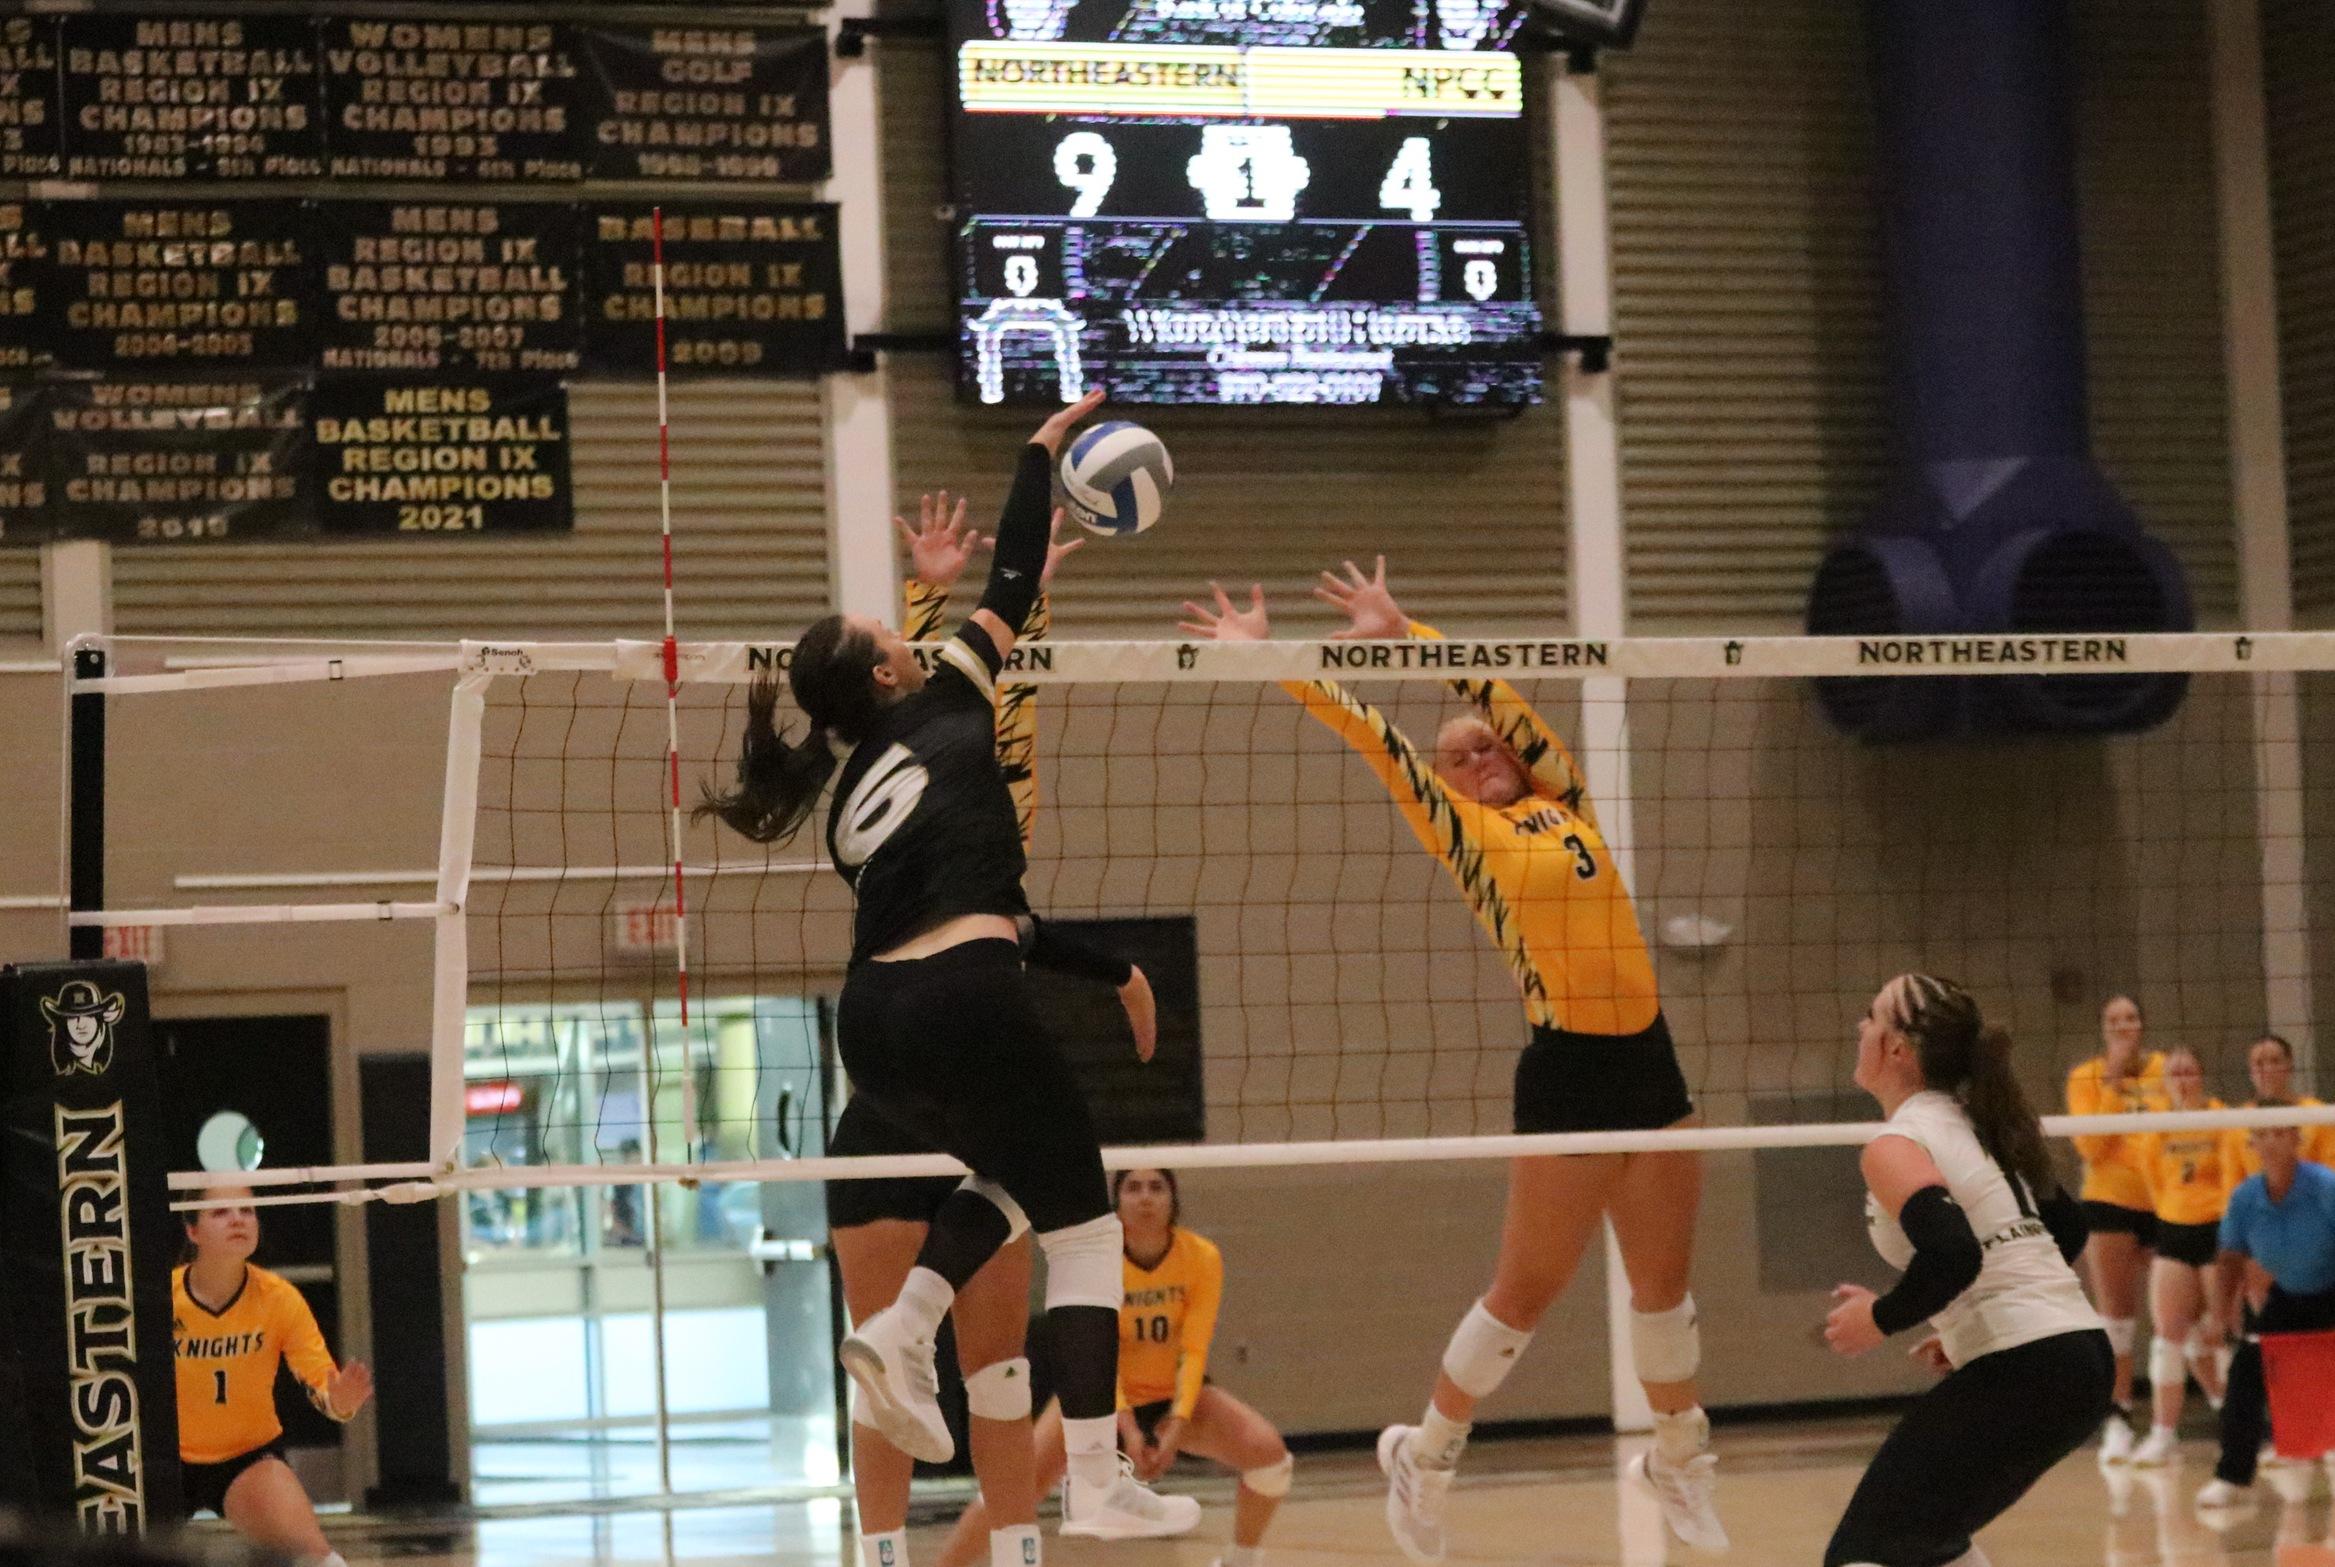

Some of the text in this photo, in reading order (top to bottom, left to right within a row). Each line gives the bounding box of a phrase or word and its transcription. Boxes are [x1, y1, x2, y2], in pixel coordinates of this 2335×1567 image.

[136, 20, 243, 47] MENS
[350, 23, 552, 50] WOMENS
[70, 49, 313, 75] BASKETBALL
[329, 50, 576, 78] VOLLEYBALL
[661, 58, 752, 83] GOLF
[973, 58, 1240, 88] NORTHEASTERN
[100, 77, 283, 102] REGION IX
[362, 79, 543, 104] REGION IX
[615, 90, 796, 117] REGION IX
[80, 104, 306, 131] CHAMPIONS
[343, 104, 566, 132] CHAMPIONS
[598, 121, 818, 147] CHAMPIONS
[1053, 132, 1117, 218] 9
[1236, 157, 1264, 209] 1
[1379, 137, 1440, 221] 4
[123, 210, 233, 237] MENS
[392, 207, 499, 234] MENS
[598, 215, 823, 242] BASEBALL
[58, 239, 302, 266] BASKETBALL
[354, 237, 537, 264] REGION IX
[88, 270, 274, 297] REGION IX
[327, 265, 568, 292] BASKETBALL
[623, 262, 802, 288] REGION IX
[1004, 256, 1038, 297] 0
[1464, 260, 1497, 301] 0
[67, 300, 297, 329] CHAMPIONS
[337, 294, 561, 322] CHAMPIONS
[603, 293, 826, 320] CHAMPIONS
[323, 350, 440, 369] NATIONALS
[91, 384, 261, 406] WOMENS
[384, 387, 492, 414] MENS
[53, 406, 300, 431] VOLLEYBALL
[316, 415, 561, 443] BASKETBALL
[87, 453, 272, 475] REGION IX
[343, 446, 538, 472] REGION IX
[65, 477, 296, 502] CHAMPIONS
[328, 474, 554, 502] CHAMPIONS
[398, 503, 484, 531] 2021
[1321, 642, 1608, 668] NORTHEASTERN
[1859, 639, 2127, 664] NORTHEASTERN
[835, 742, 929, 866] 6
[1563, 833, 1597, 880] 3
[1135, 1315, 1169, 1343] 10
[173, 1331, 265, 1358] KNIGHTS
[214, 1369, 227, 1405] 1
